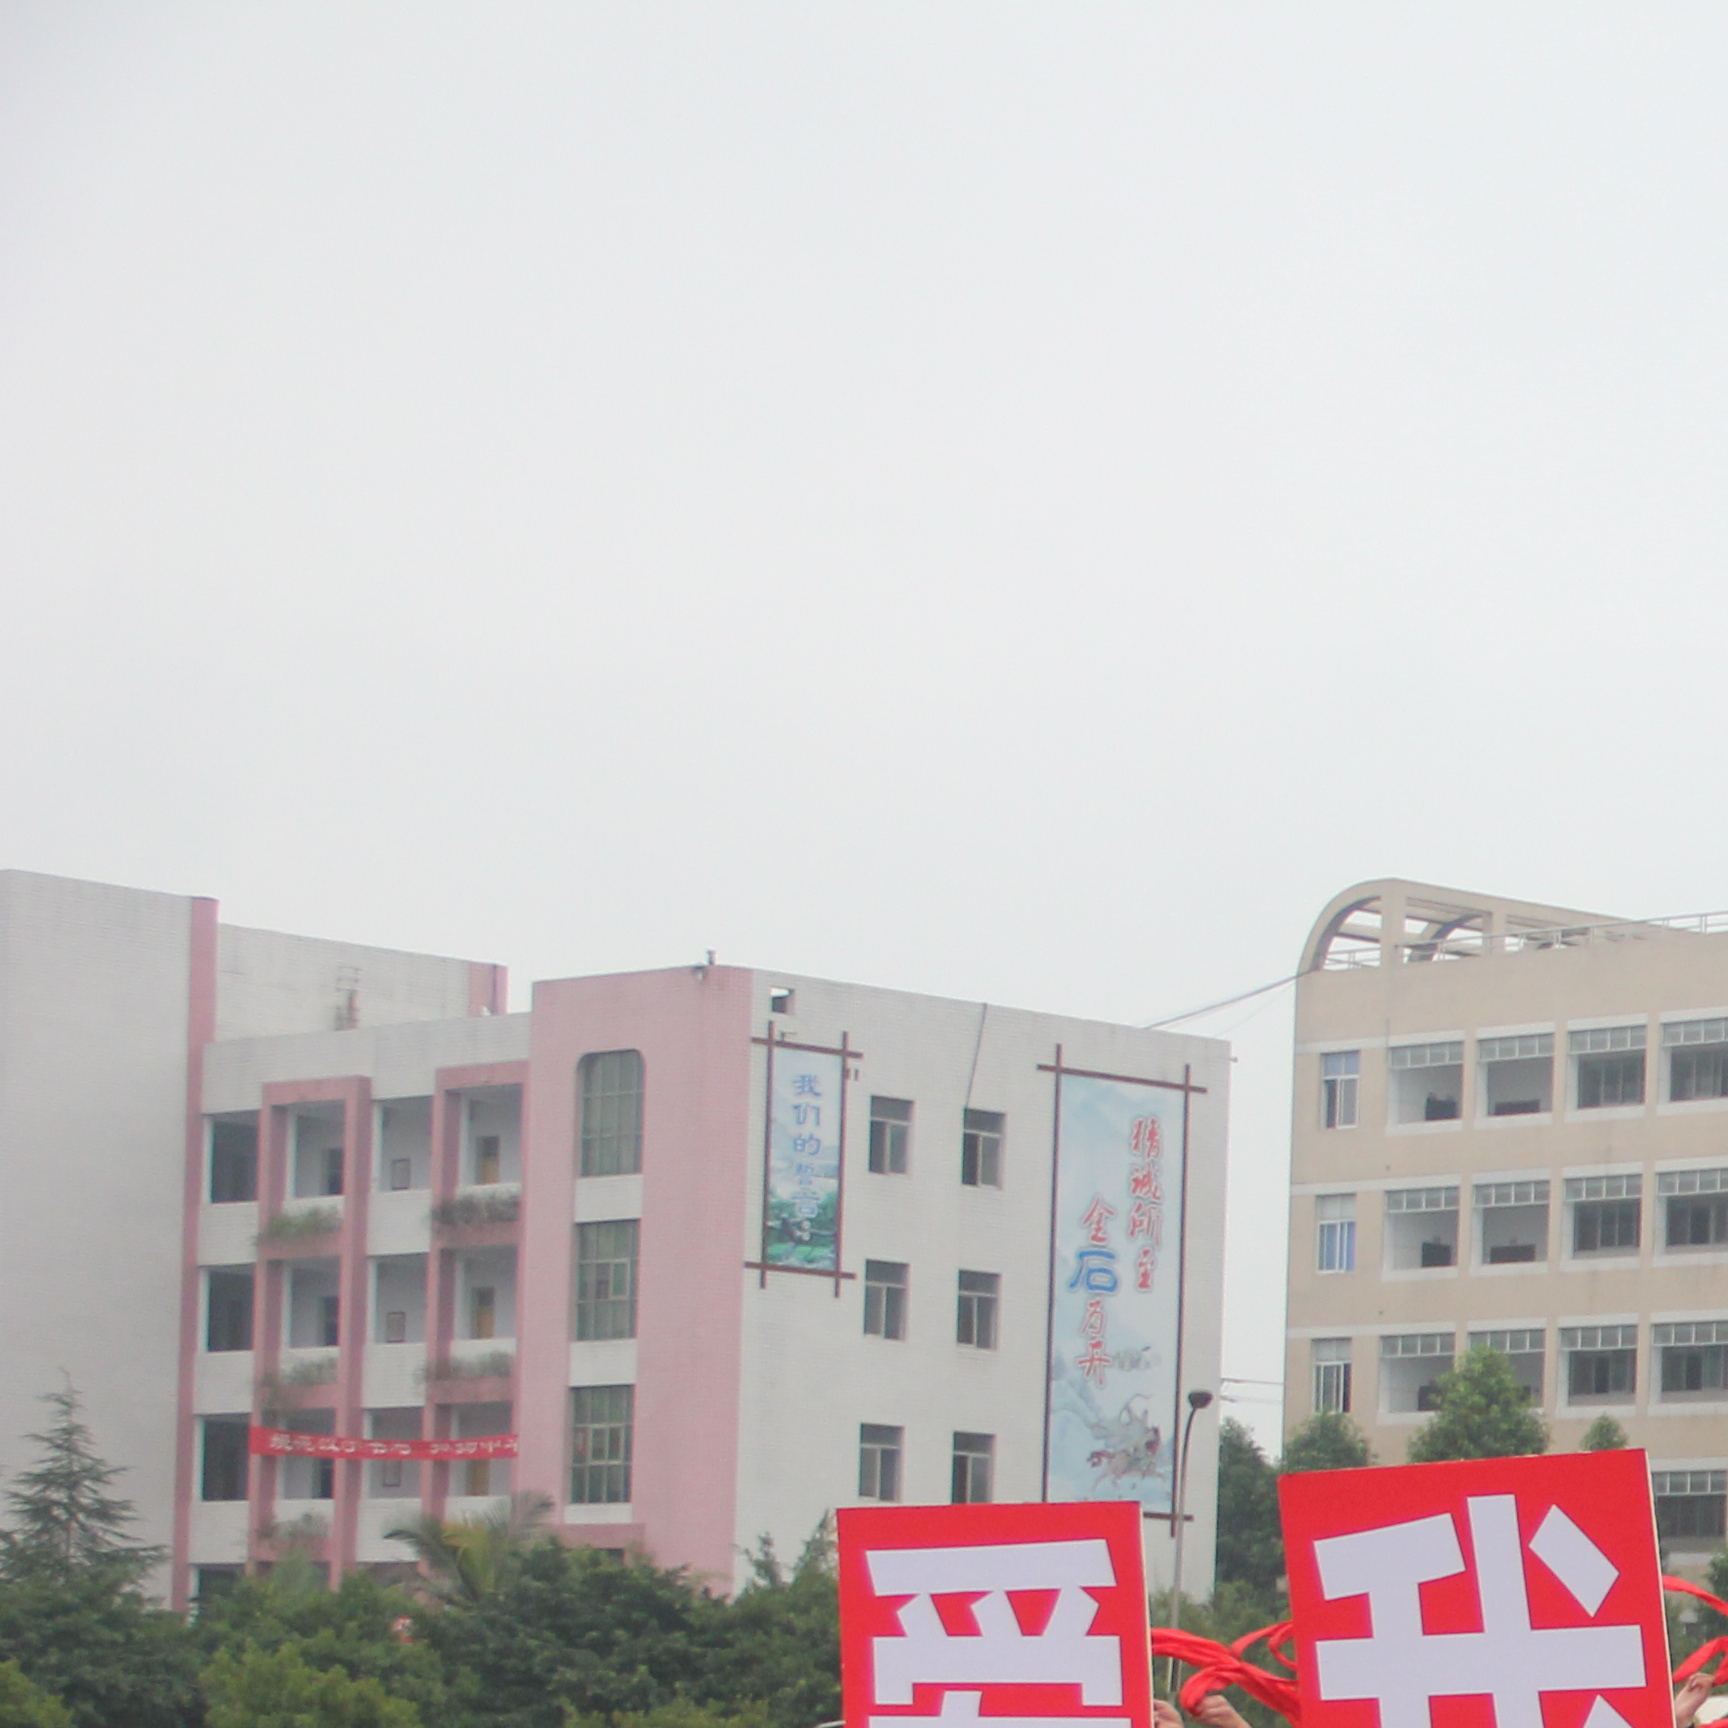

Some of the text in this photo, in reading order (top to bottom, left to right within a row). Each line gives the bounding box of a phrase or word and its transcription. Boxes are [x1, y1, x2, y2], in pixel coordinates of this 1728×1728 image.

[1068, 1195, 1120, 1387] 金石为开
[1128, 1115, 1163, 1293] 精诚所至
